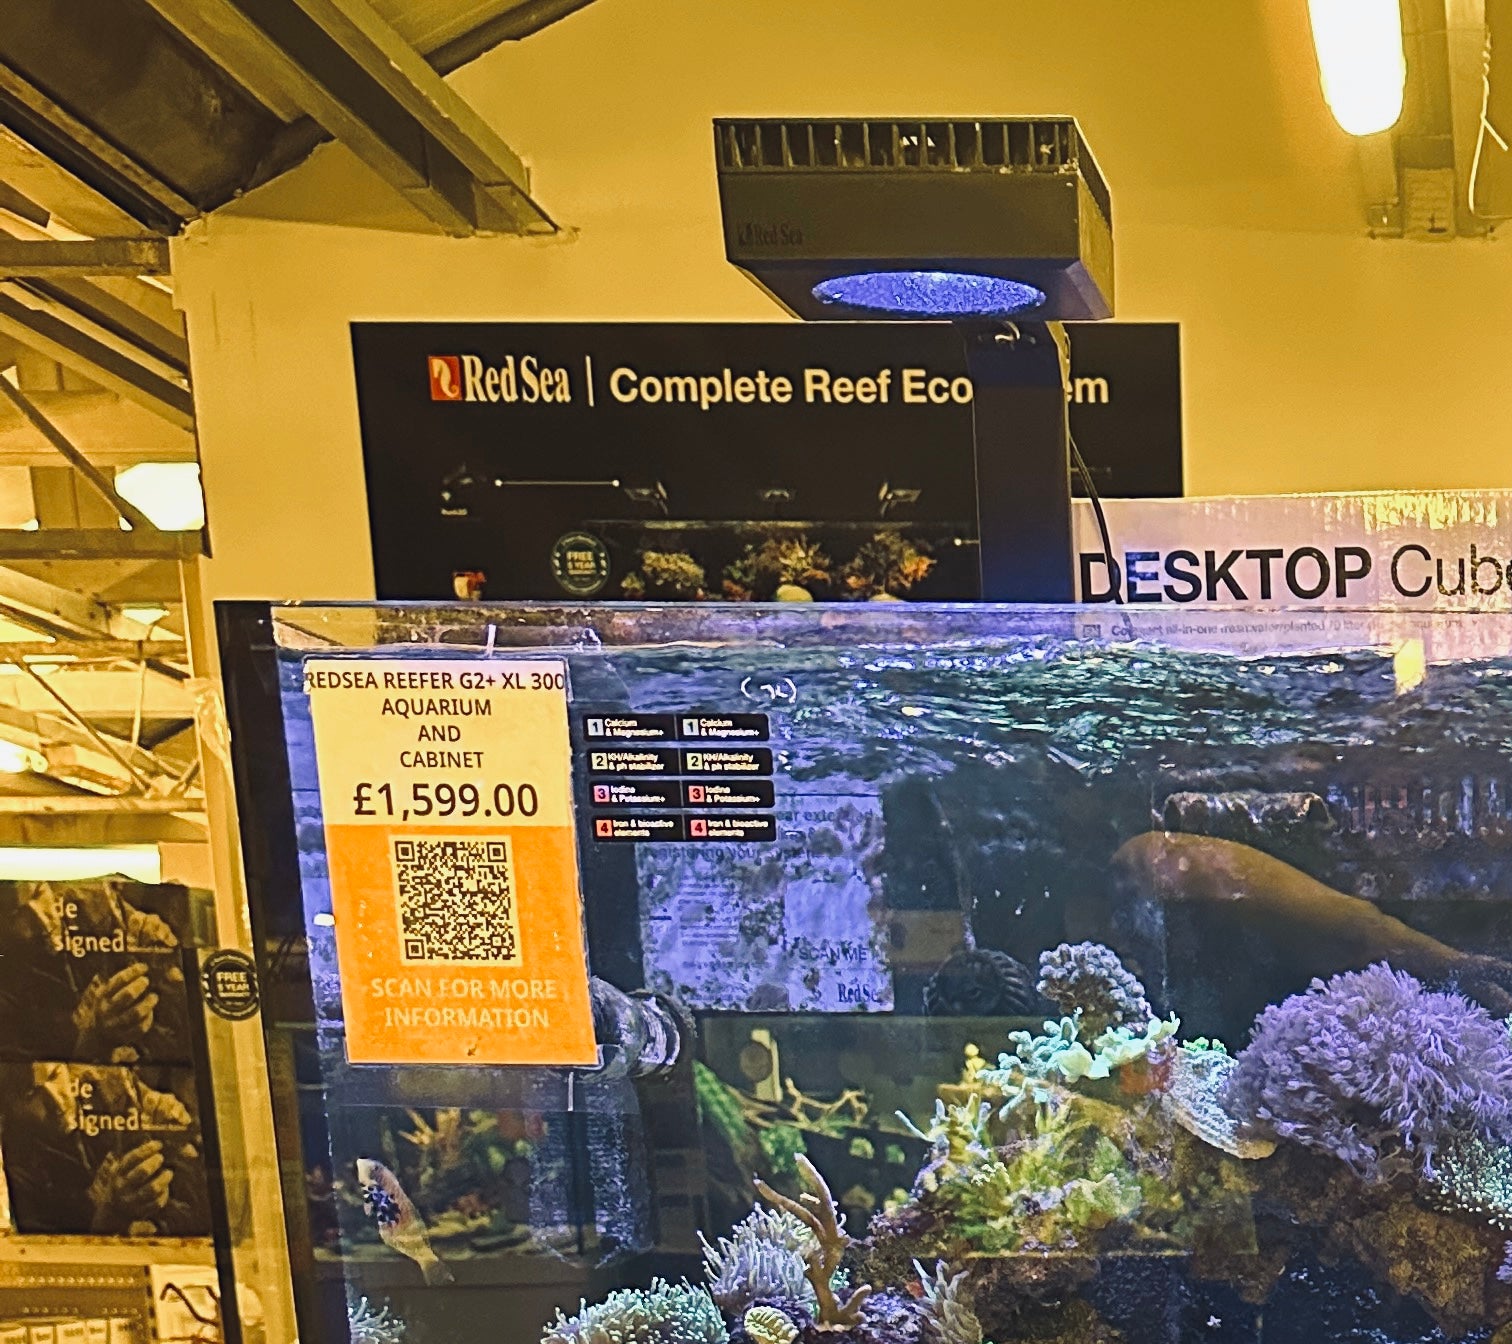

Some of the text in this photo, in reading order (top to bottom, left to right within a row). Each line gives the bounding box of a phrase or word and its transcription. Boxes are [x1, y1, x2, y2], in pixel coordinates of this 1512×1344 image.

[609, 366, 793, 411] Complete
[804, 368, 891, 404] Reef
[1079, 546, 1371, 604] DESKTOP
[307, 671, 565, 690] REDSEA REEFER G2+ XL 300
[382, 699, 492, 719] AQUARIUM
[418, 725, 461, 742] AND
[400, 751, 484, 768] CABINET
[353, 782, 538, 821] £1,599.00
[53, 897, 78, 918] de
[54, 928, 125, 957] signed
[370, 977, 557, 999] SCAN FOR MORE
[385, 1007, 550, 1028] INFORMATION
[69, 1078, 93, 1098] de
[69, 1108, 140, 1136] signed
